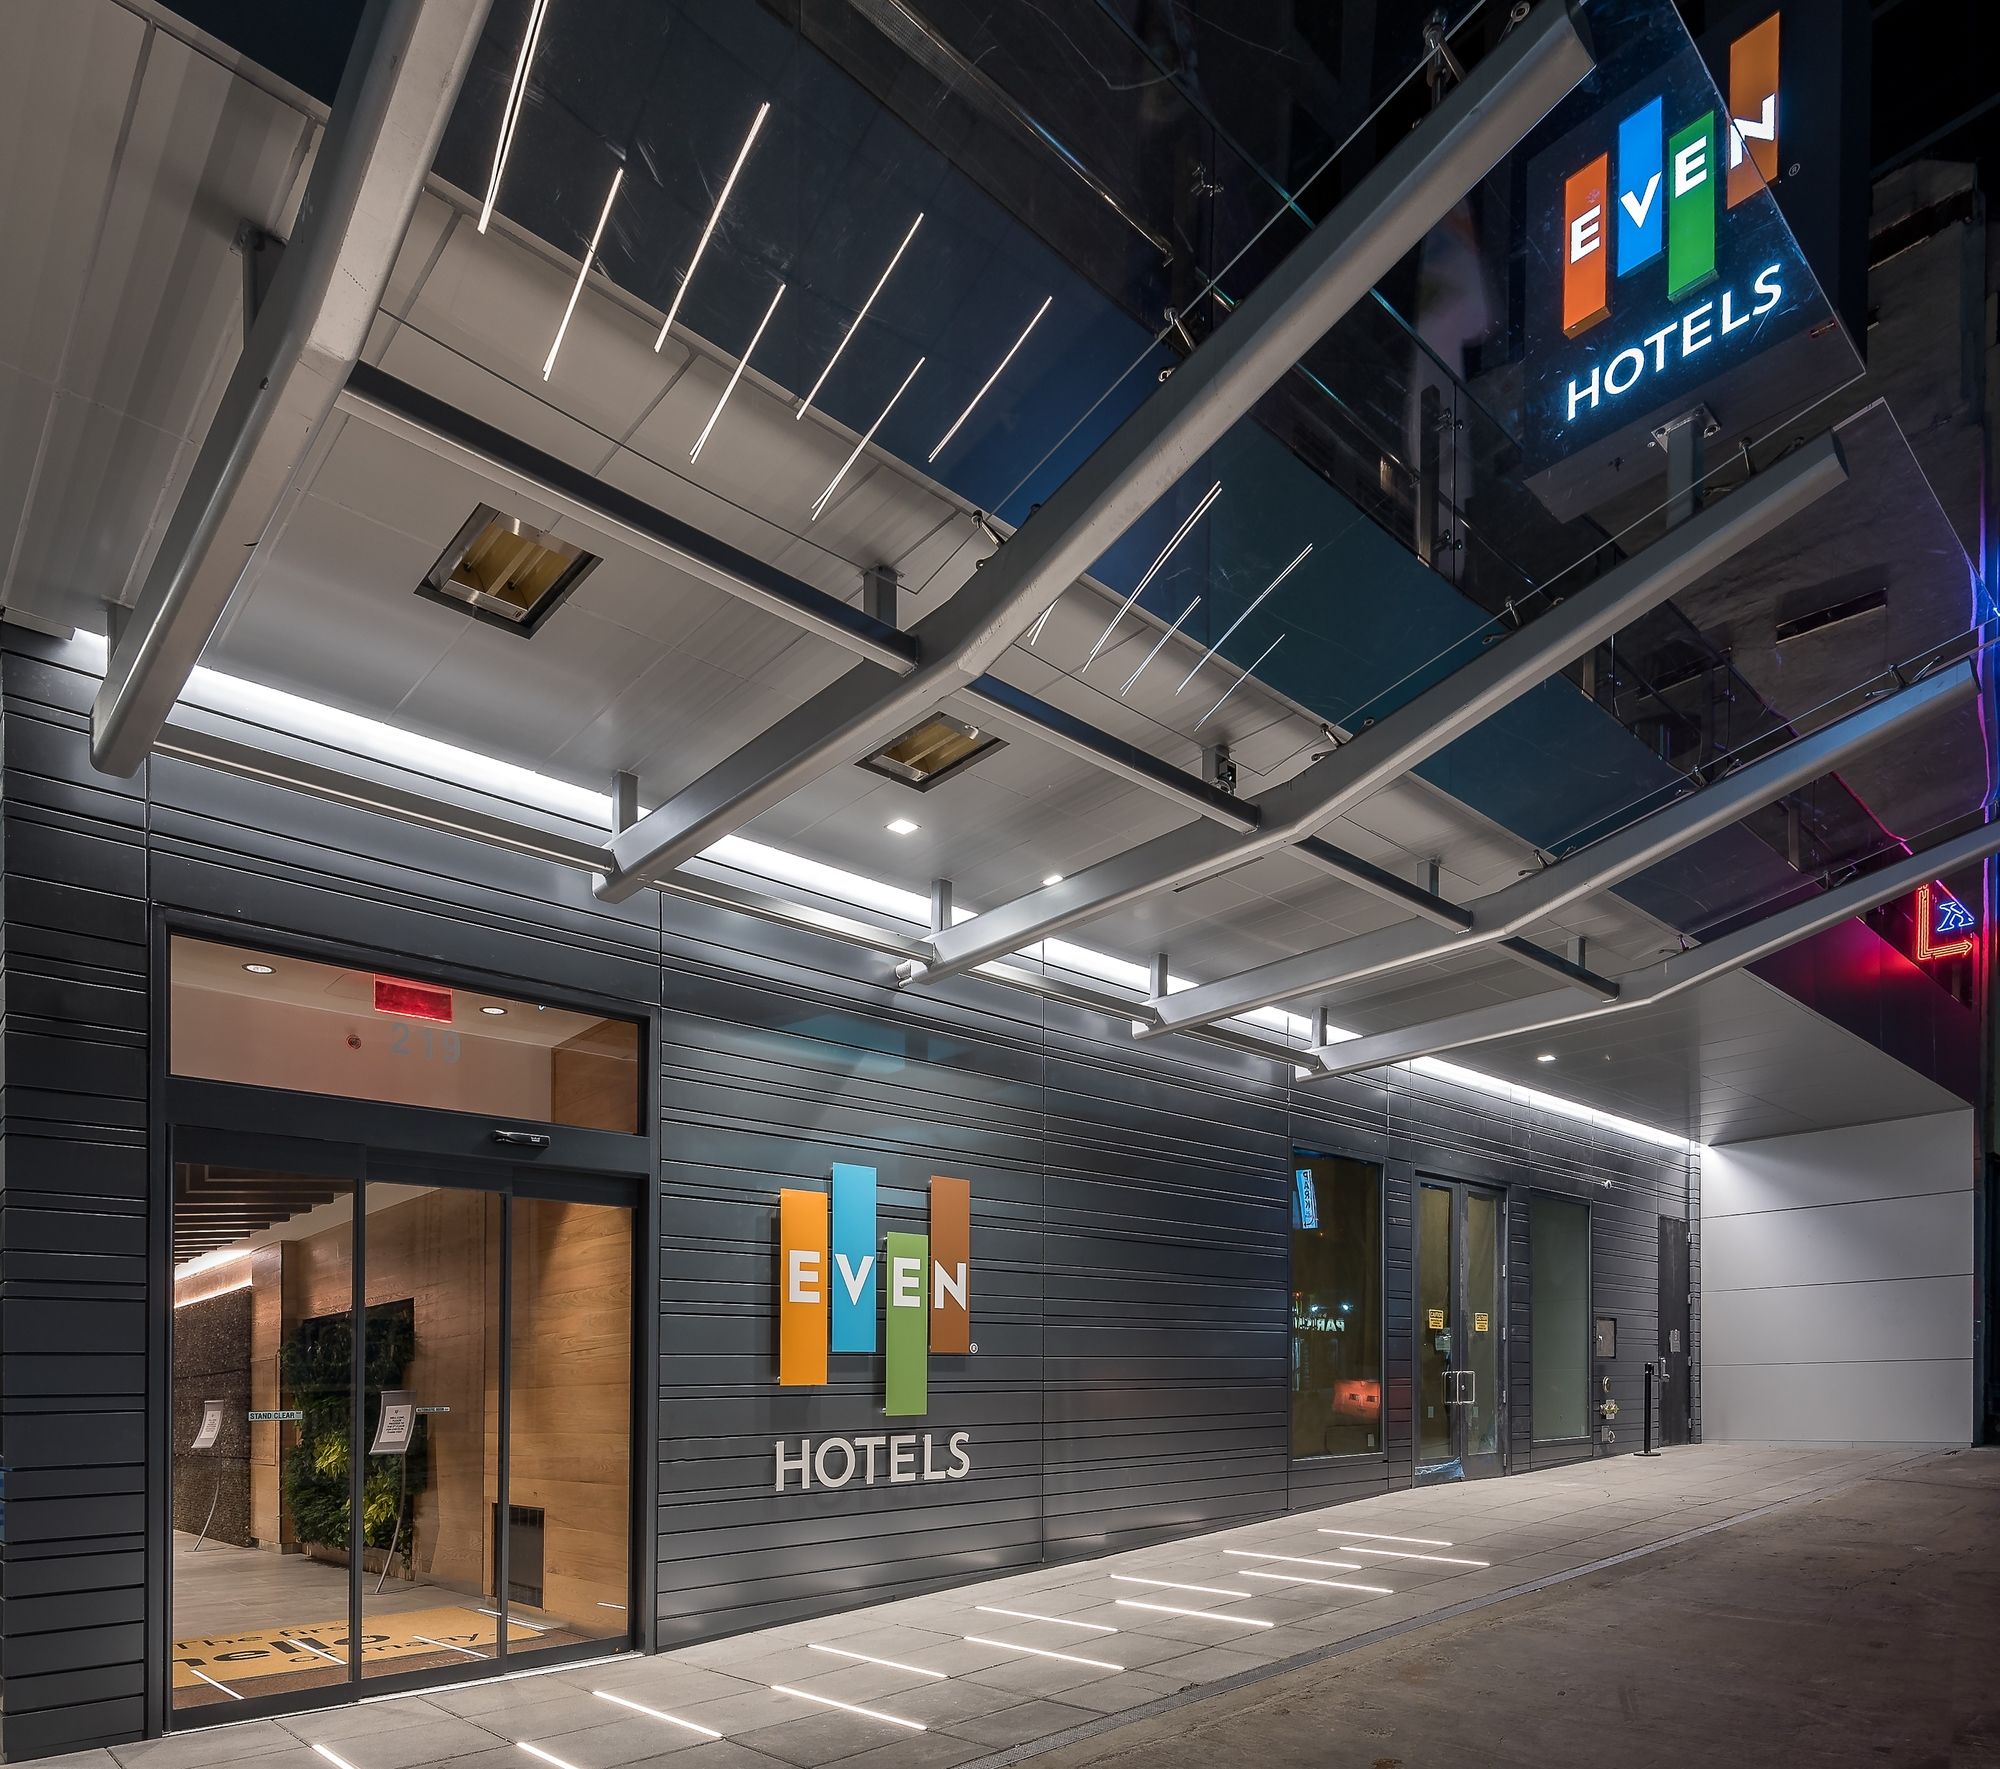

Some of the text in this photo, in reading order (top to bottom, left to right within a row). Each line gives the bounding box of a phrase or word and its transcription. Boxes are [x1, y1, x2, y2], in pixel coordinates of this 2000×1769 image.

[1569, 92, 1777, 265] EVEN
[1566, 263, 1783, 422] HOTELS
[390, 1022, 463, 1064] 219
[788, 1249, 968, 1312] EVEN
[249, 1412, 272, 1420] STAND
[273, 1411, 295, 1419] CLEAR
[774, 1430, 972, 1493] HOTELS
